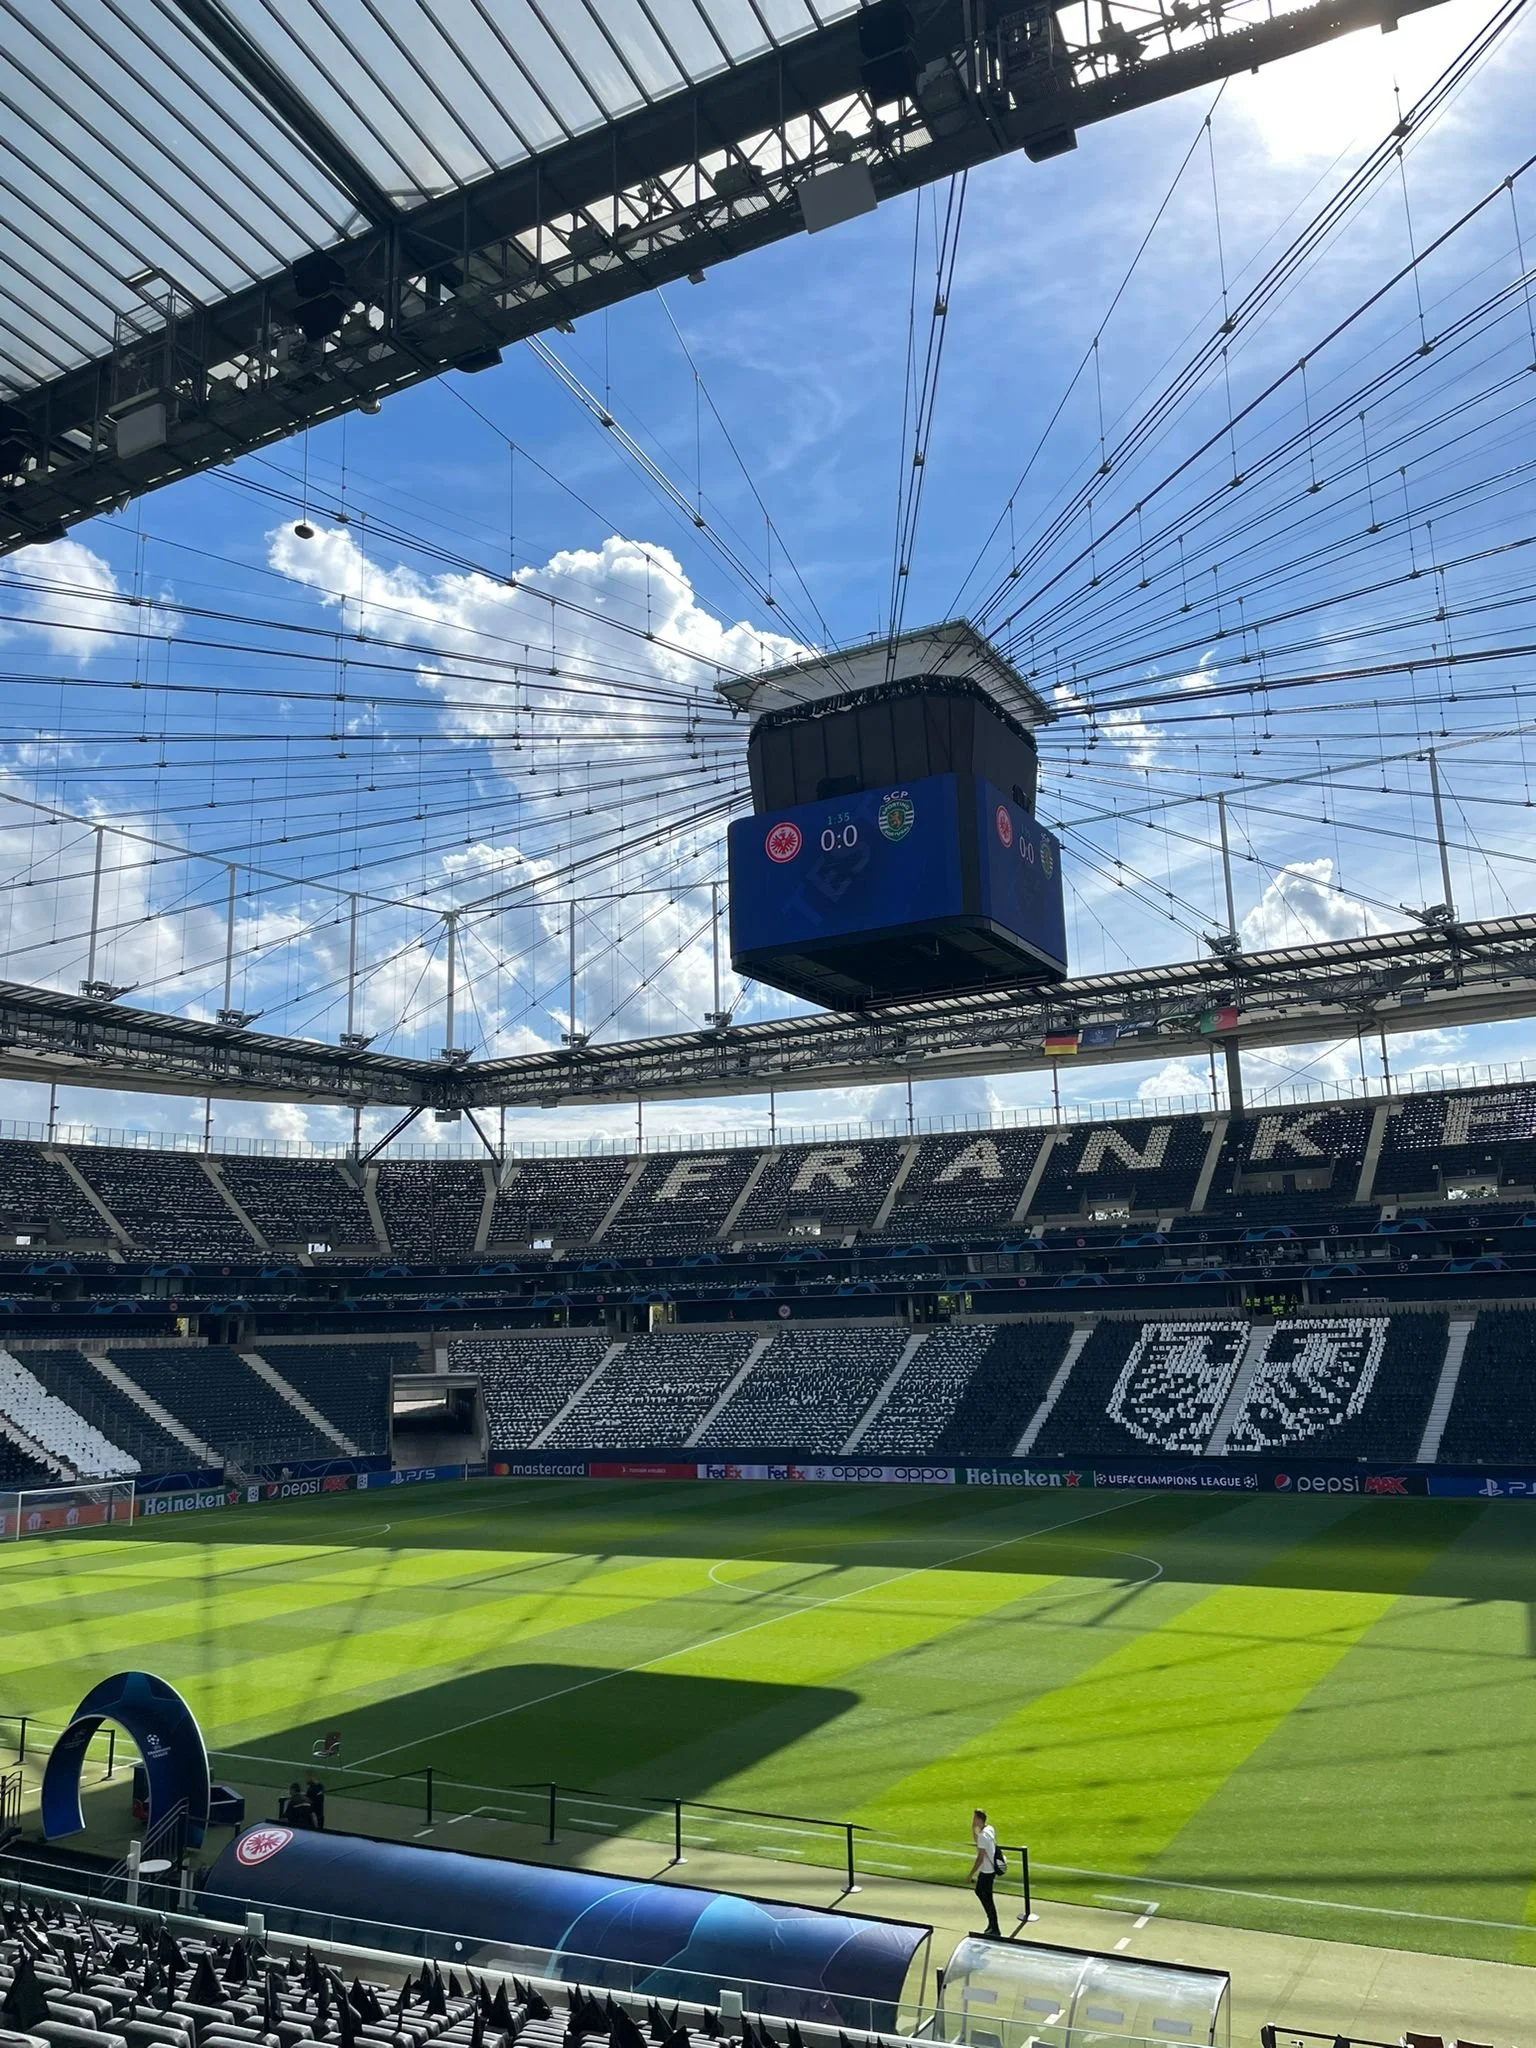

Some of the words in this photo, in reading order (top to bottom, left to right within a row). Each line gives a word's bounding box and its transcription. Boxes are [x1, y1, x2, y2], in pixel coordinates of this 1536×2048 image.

[883, 791, 909, 803] SCP
[827, 812, 850, 825] 1:35
[820, 824, 858, 852] 0:0
[406, 1468, 436, 1482] PS5
[512, 1463, 585, 1476] mastercard
[706, 1464, 742, 1480] FedEx
[767, 1465, 806, 1480] FedEx
[966, 1468, 1062, 1487] Heineken
[1108, 1474, 1136, 1484] UEFA
[1137, 1475, 1198, 1486] CHAMPIONS
[1201, 1476, 1241, 1487] LEAGUE
[1297, 1475, 1360, 1493] pepsi
[281, 1479, 320, 1498] pepsi
[143, 1493, 226, 1516] Heineken
